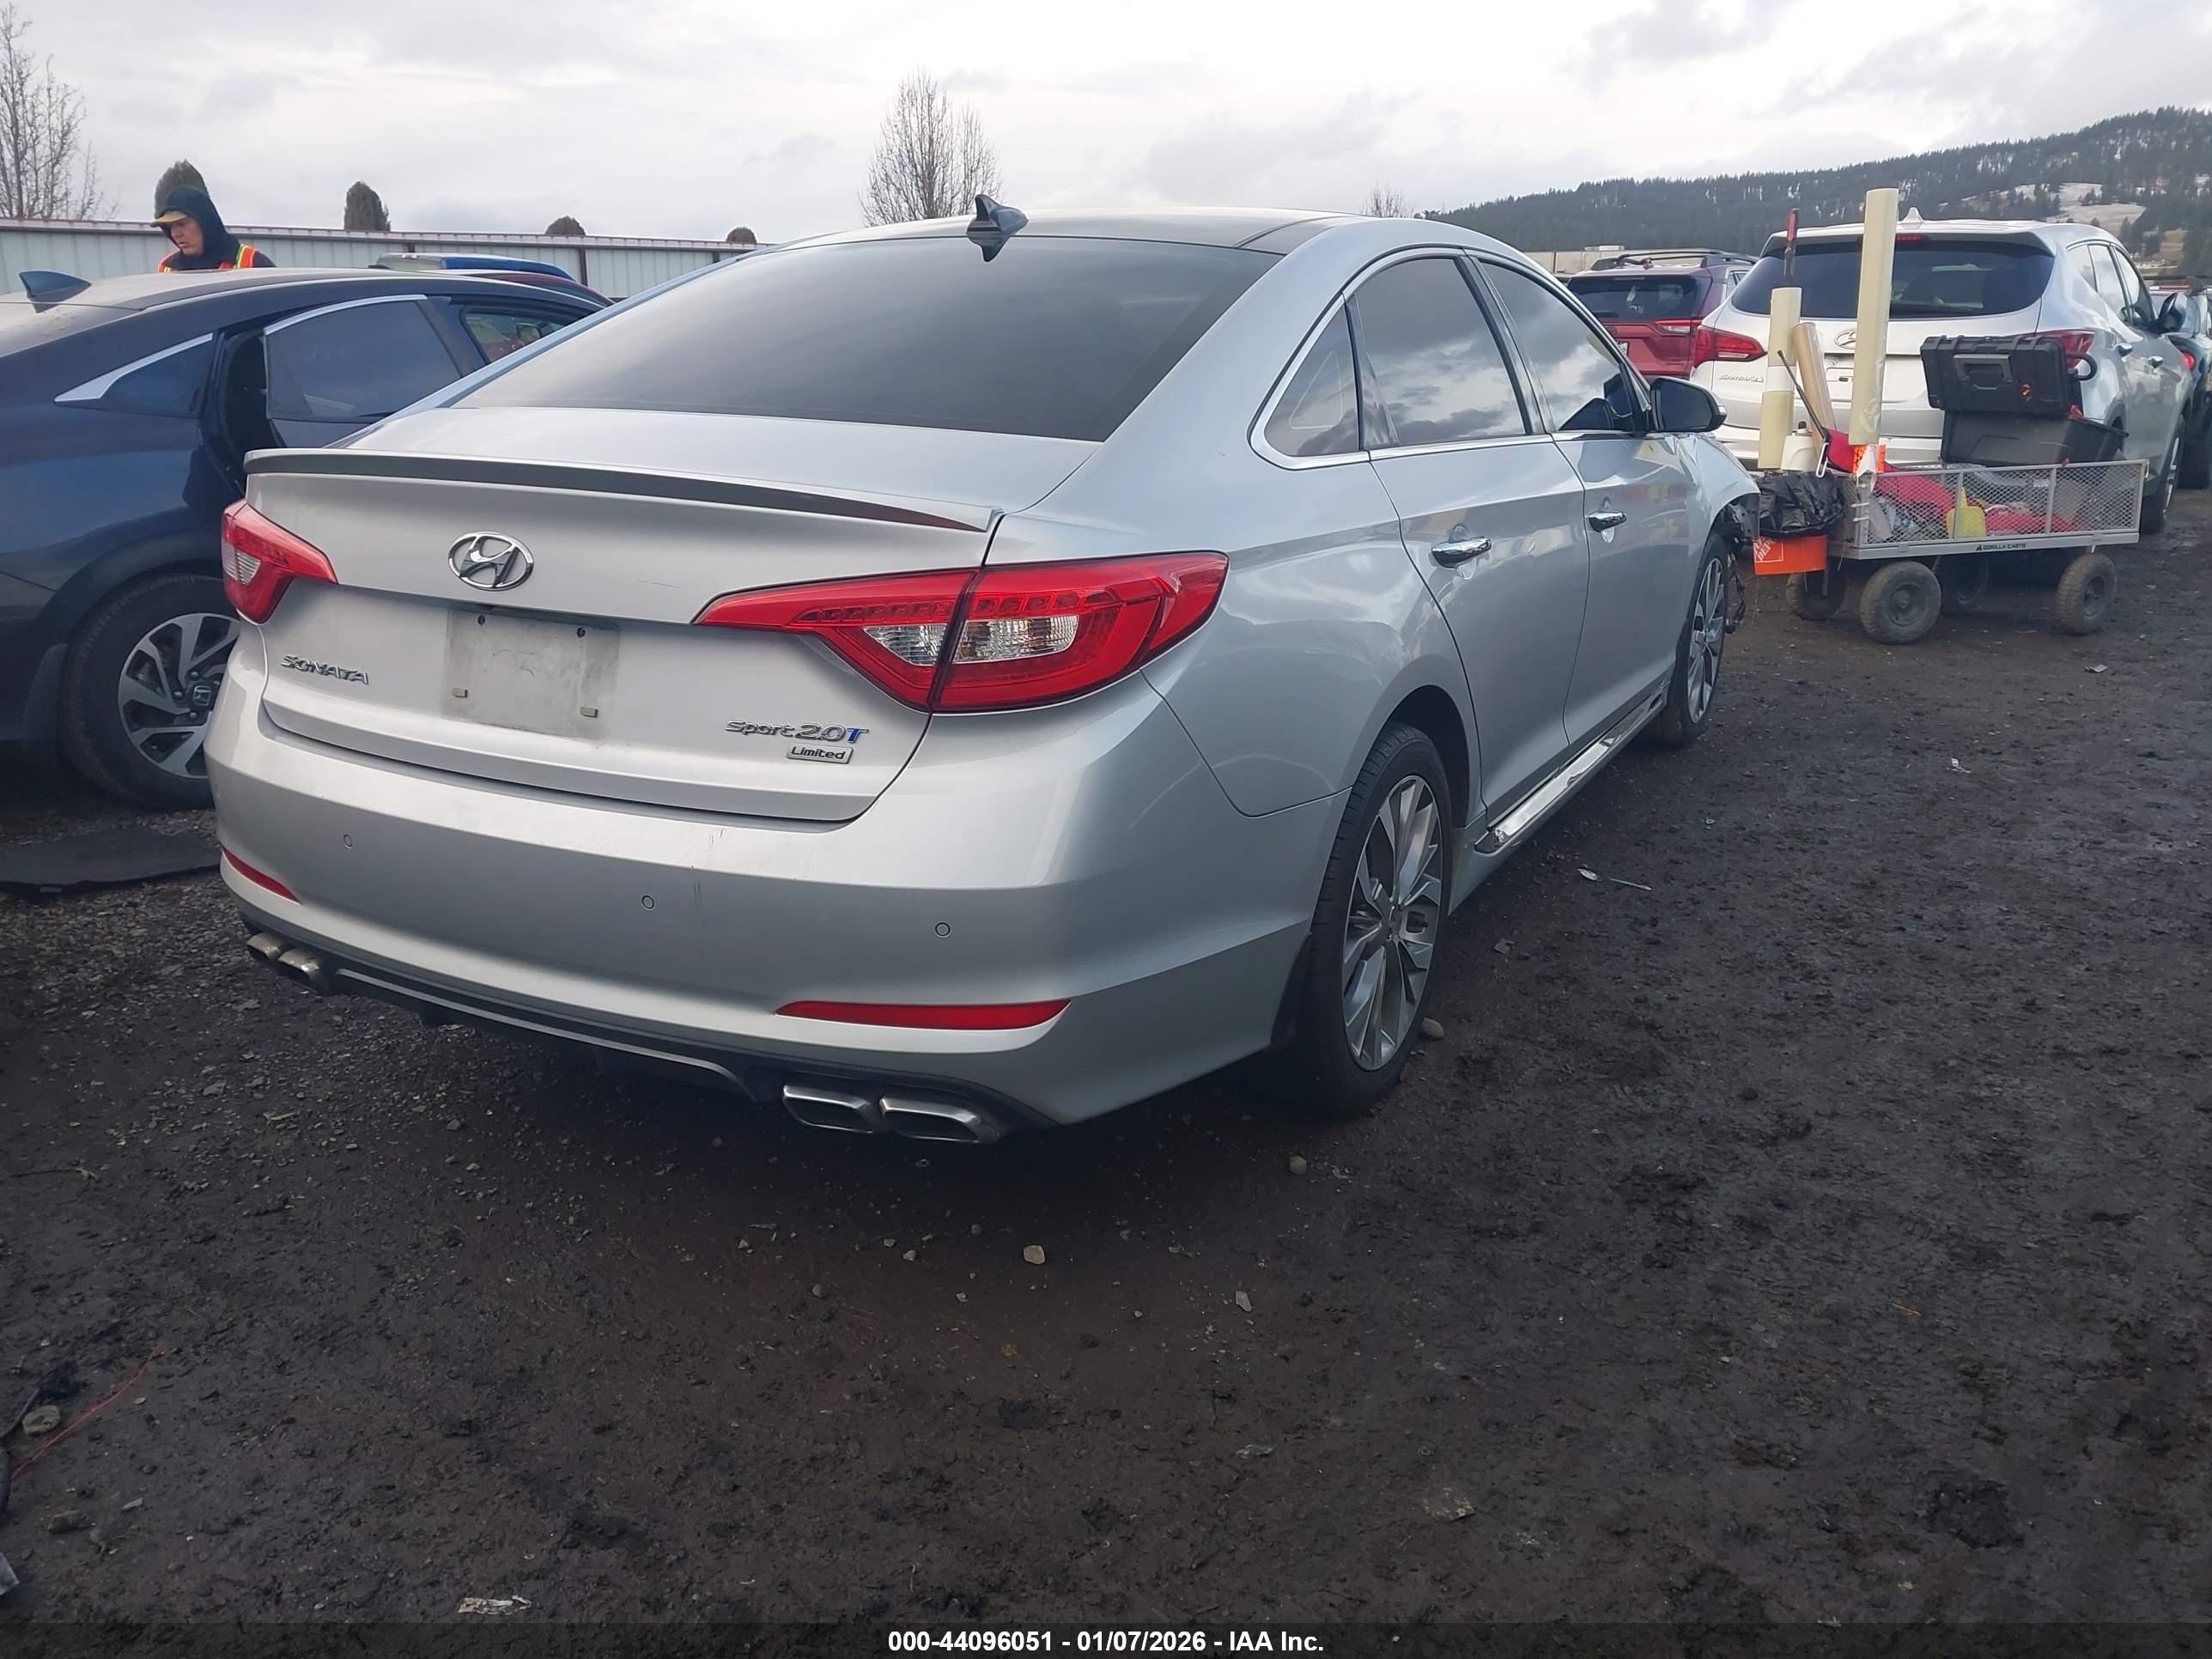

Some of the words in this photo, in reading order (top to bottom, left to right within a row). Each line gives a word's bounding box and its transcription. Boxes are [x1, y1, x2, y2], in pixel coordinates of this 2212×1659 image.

[280, 653, 369, 685] SONATA
[724, 720, 795, 738] Sport
[790, 745, 847, 760] Limited
